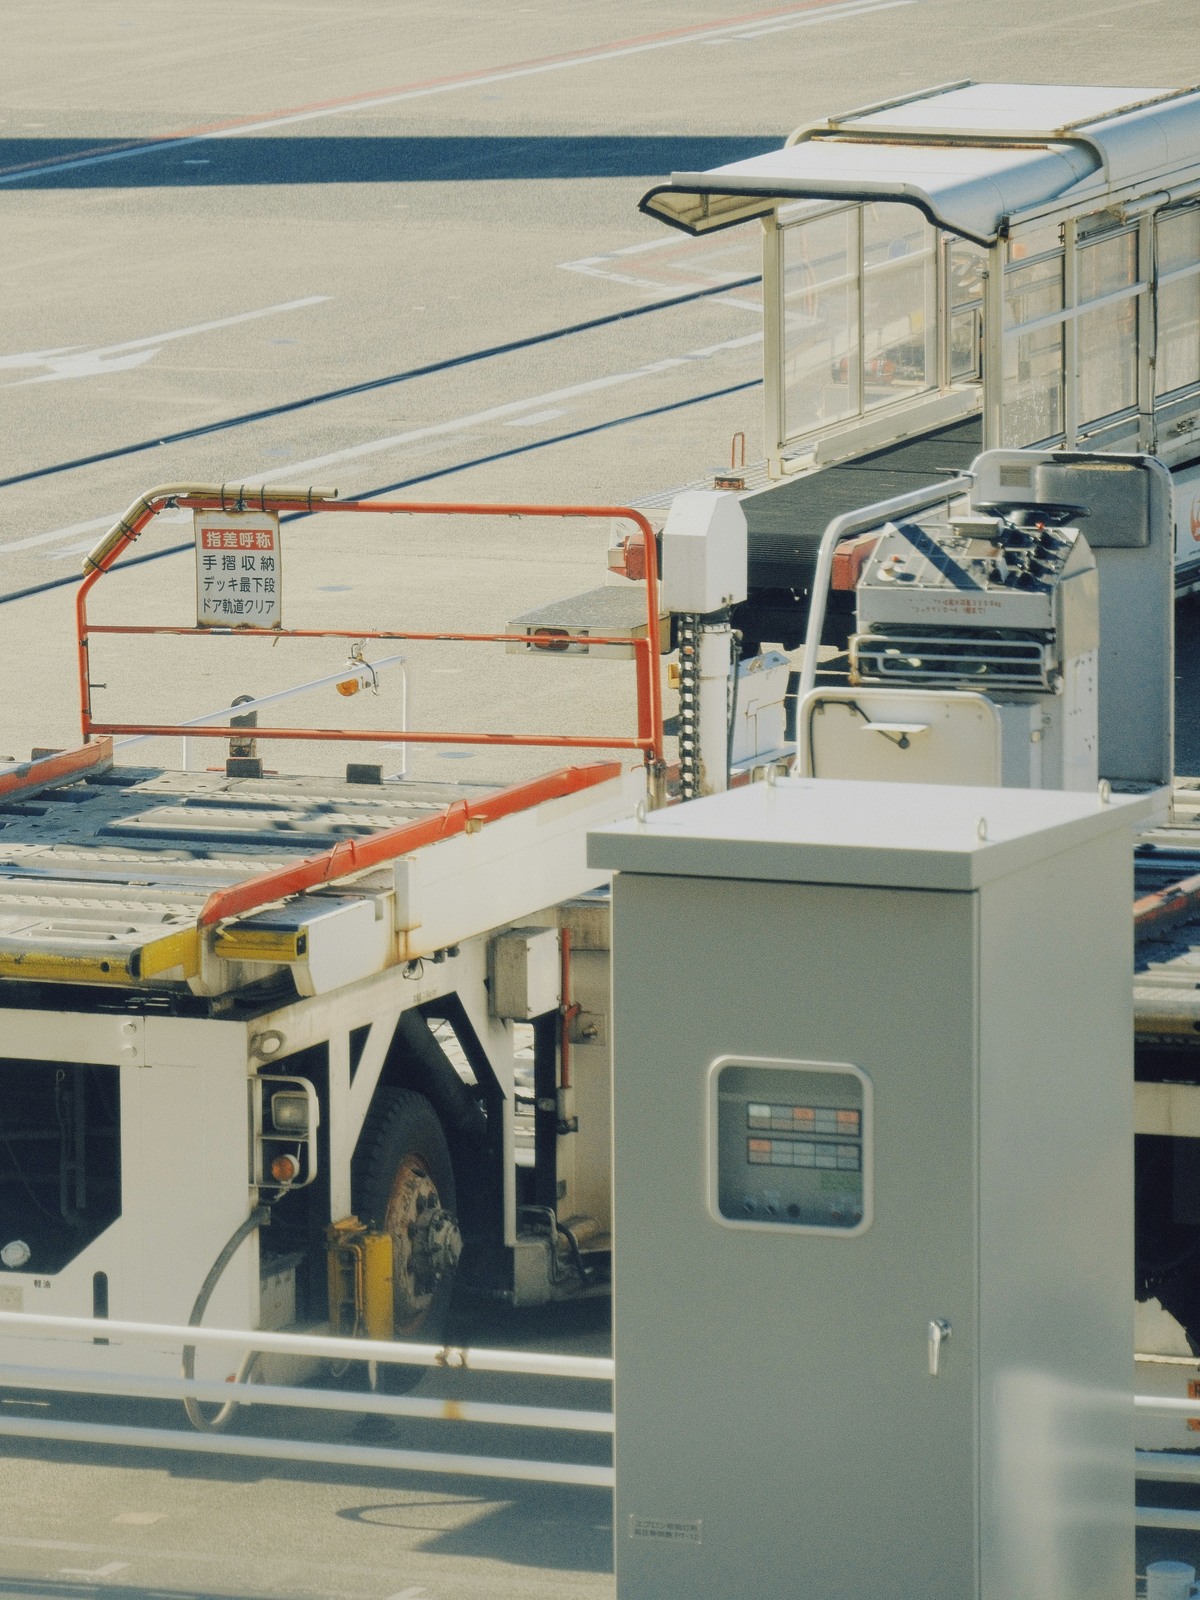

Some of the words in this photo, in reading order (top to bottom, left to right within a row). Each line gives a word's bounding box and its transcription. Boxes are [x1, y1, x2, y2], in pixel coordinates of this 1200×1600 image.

[206, 531, 272, 549] 指差呼称
[202, 554, 275, 572] 手摺収納
[203, 576, 275, 593] デッキ最下段
[203, 597, 275, 615] ドア軌道クリア
